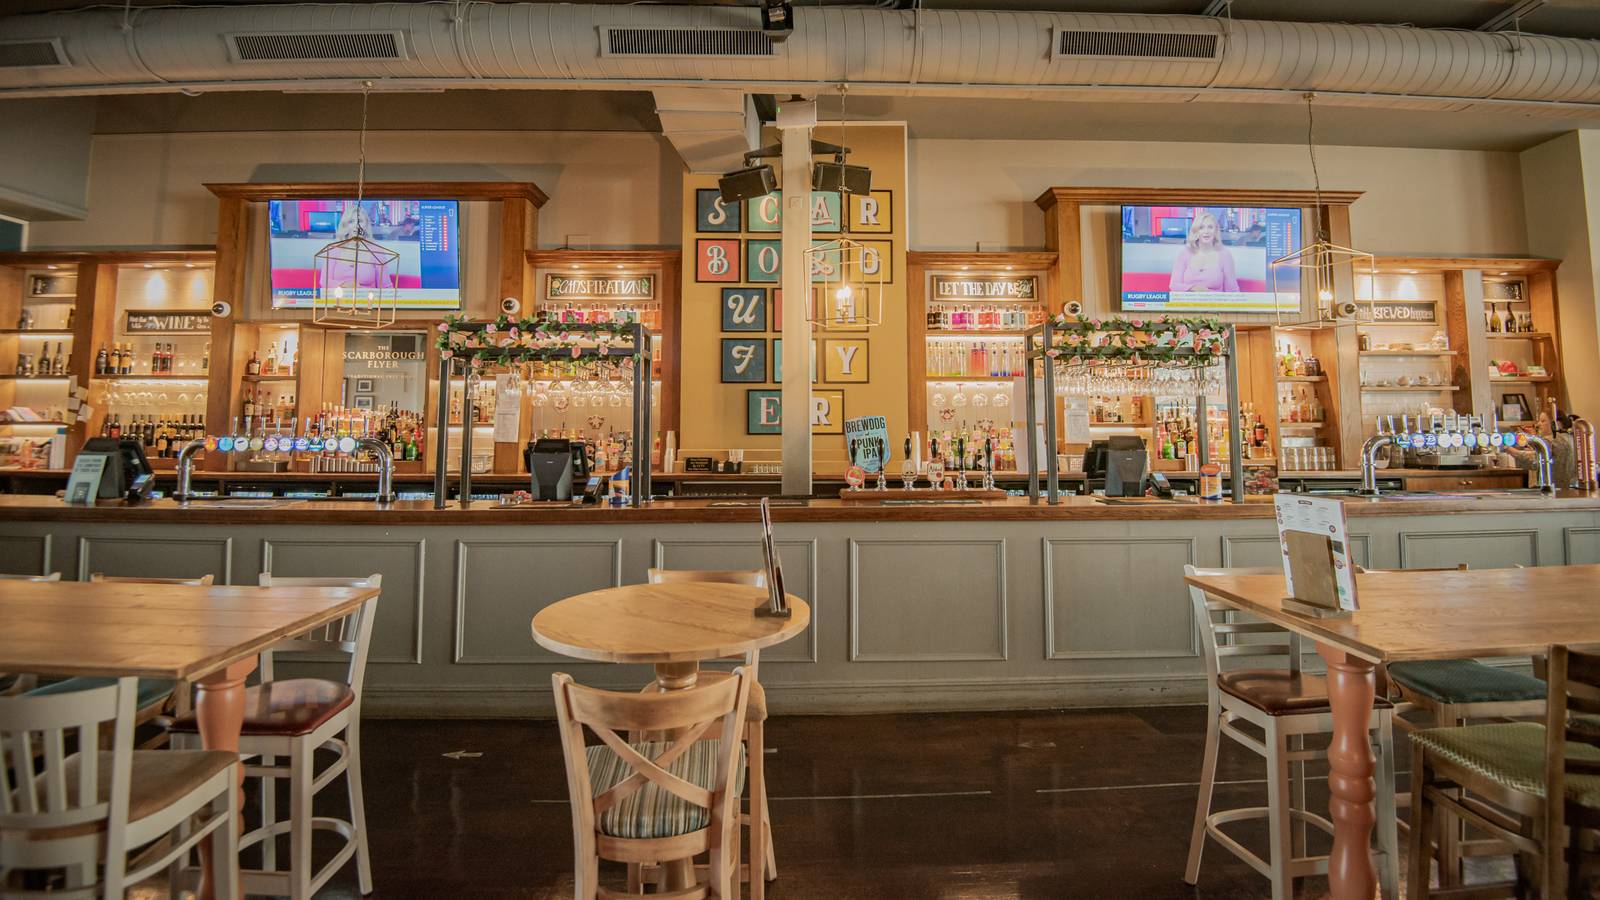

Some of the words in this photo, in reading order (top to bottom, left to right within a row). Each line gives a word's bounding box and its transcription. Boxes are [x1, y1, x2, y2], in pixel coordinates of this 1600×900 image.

[939, 281, 959, 296] LET
[960, 281, 985, 296] THE
[985, 281, 1007, 296] DAY
[149, 315, 195, 330] WINE
[342, 351, 425, 360] SCARBOROUGH
[367, 360, 399, 369] FLYER
[845, 416, 886, 434] BREWDOG
[863, 447, 878, 459] IPA
